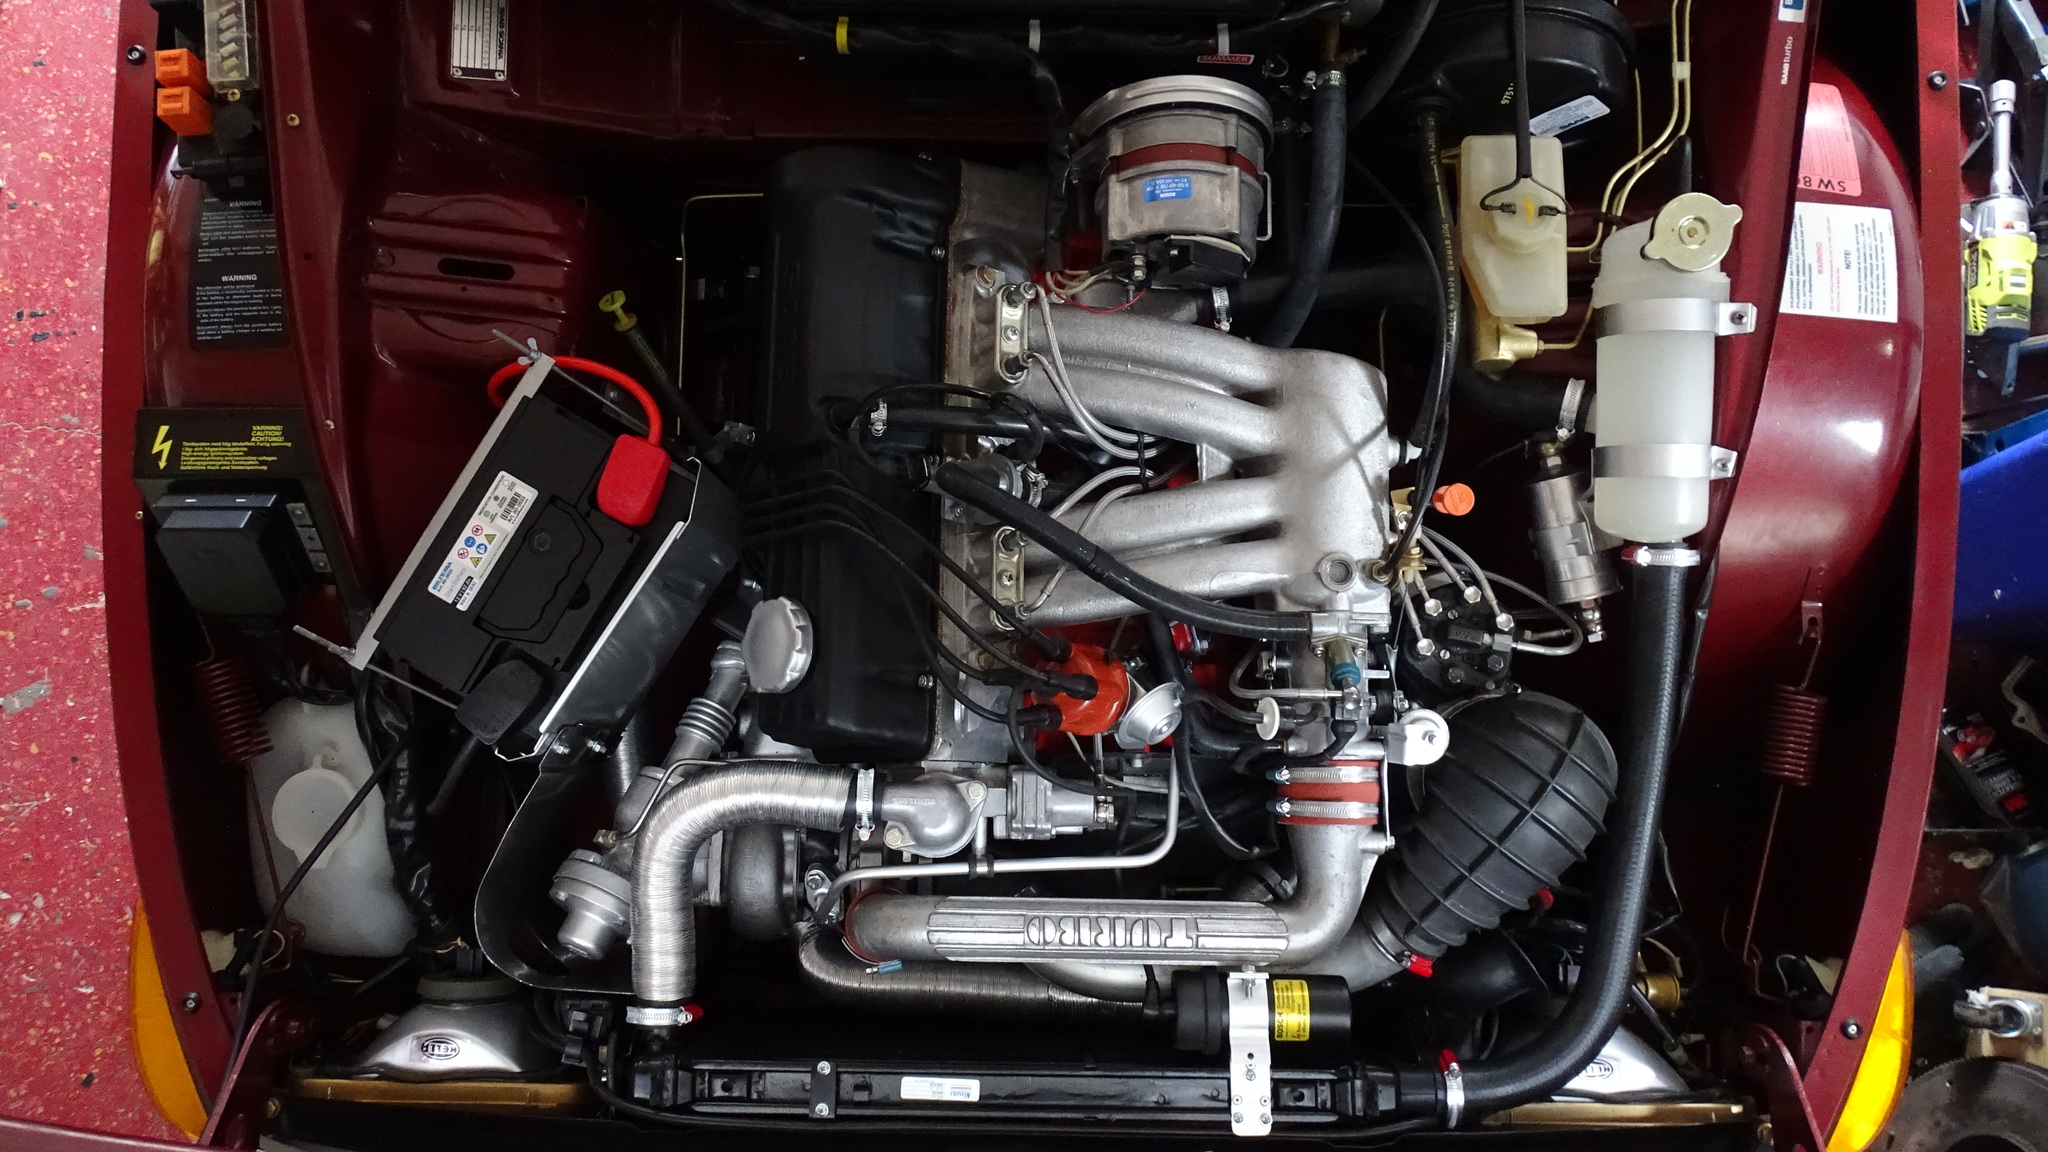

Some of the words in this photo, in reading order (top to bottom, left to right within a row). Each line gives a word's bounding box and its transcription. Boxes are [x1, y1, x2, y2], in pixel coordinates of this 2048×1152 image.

[1797, 176, 1812, 187] 8
[1818, 178, 1846, 192] SW
[222, 274, 257, 282] WARNING
[432, 561, 453, 591] BILTEMA
[1027, 915, 1194, 948] TURBO
[421, 1042, 457, 1053] HELLA
